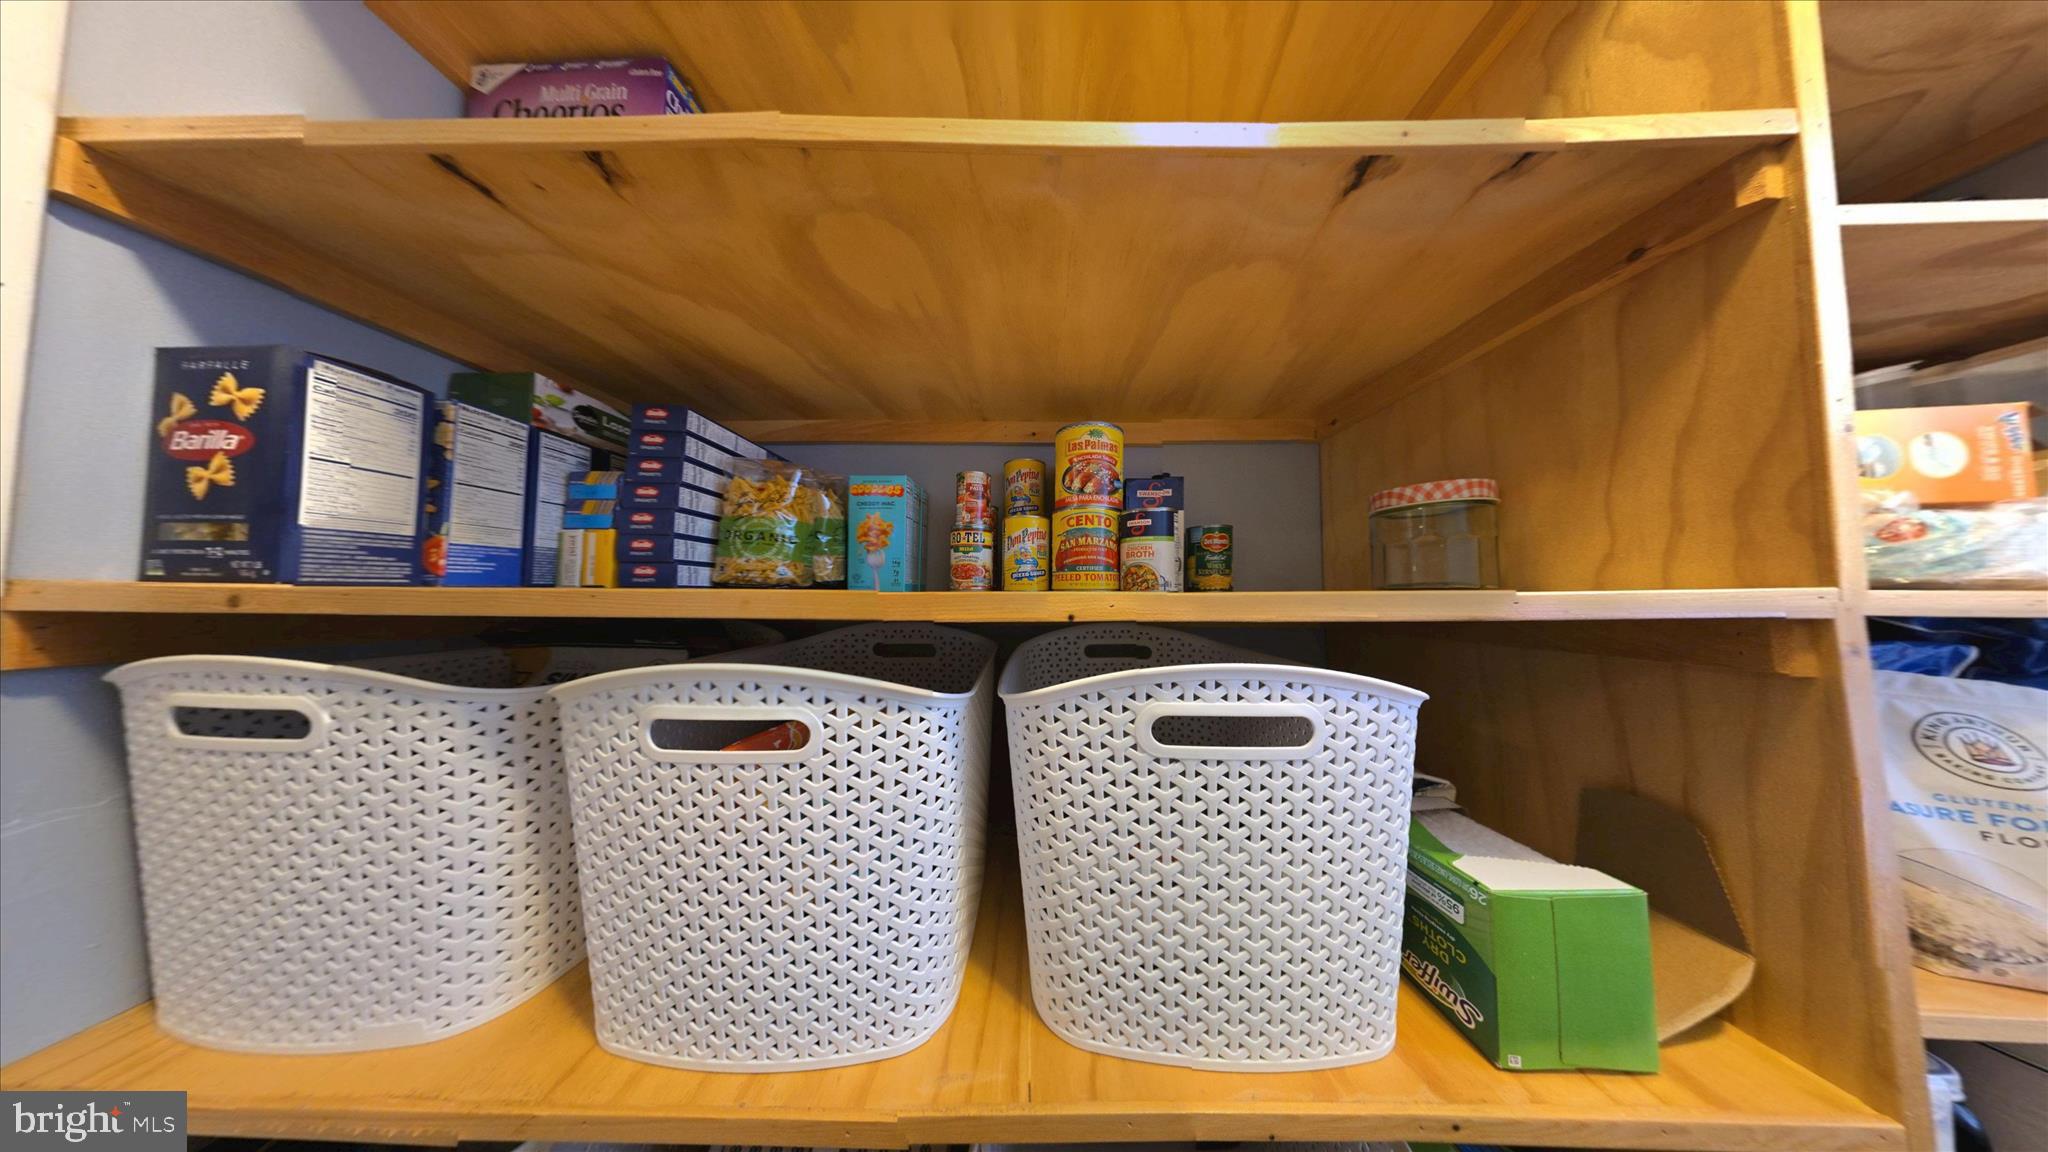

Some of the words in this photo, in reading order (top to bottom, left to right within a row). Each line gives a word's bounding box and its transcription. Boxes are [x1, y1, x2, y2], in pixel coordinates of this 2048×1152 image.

[540, 85, 581, 102] Multi
[583, 83, 629, 101] Grain
[169, 429, 246, 450] Barilla
[1067, 441, 1084, 453] Las
[1085, 439, 1120, 453] Palmas
[1066, 514, 1112, 528] CENTO
[1125, 551, 1155, 559] BROTH
[1435, 889, 1461, 915] 95%
[1402, 949, 1485, 1031] Swiffer
